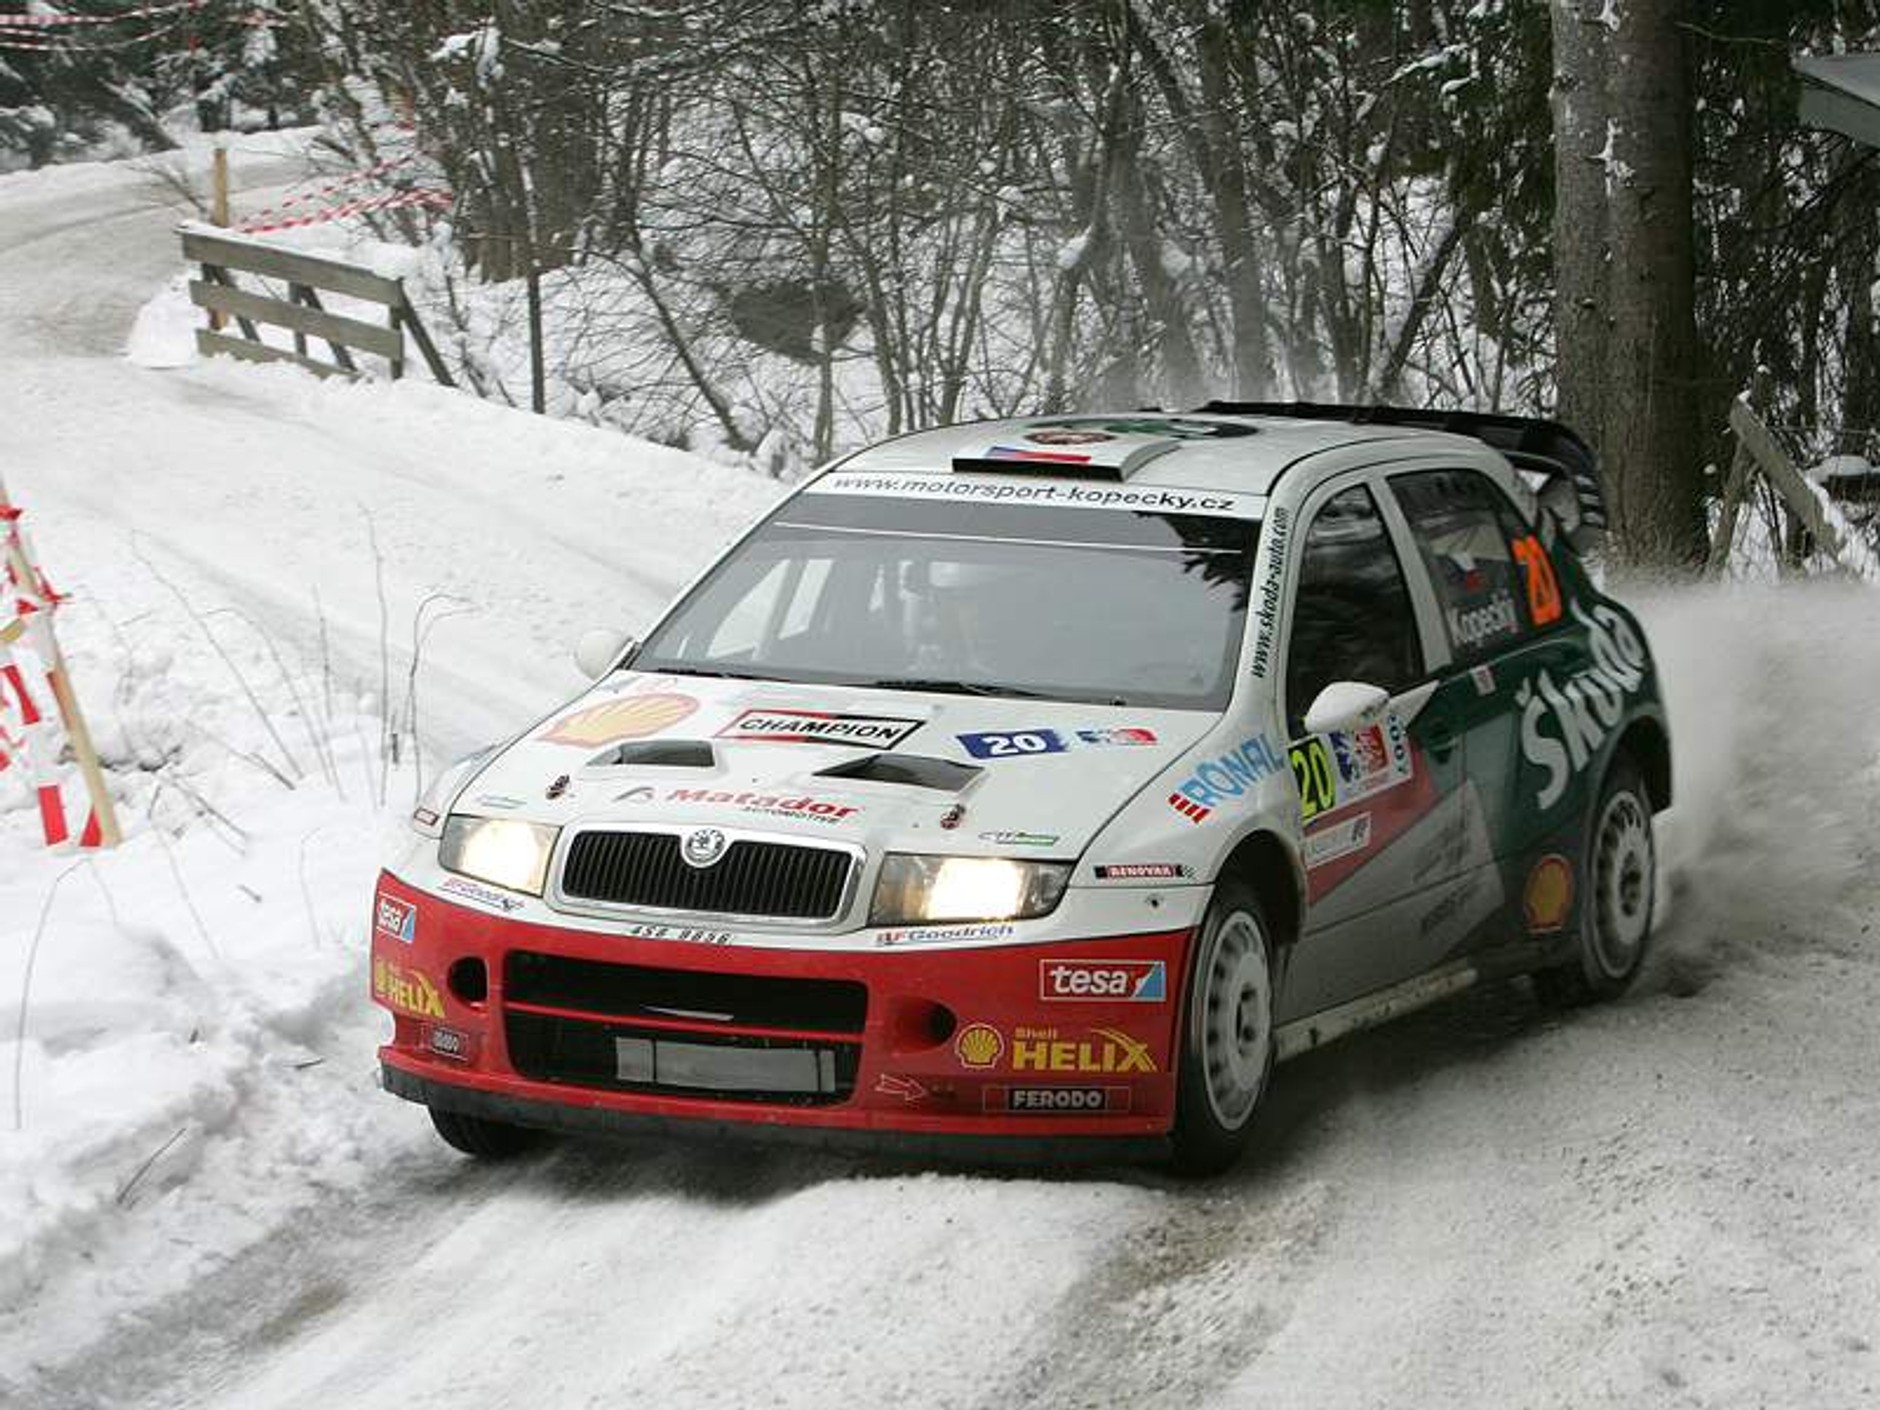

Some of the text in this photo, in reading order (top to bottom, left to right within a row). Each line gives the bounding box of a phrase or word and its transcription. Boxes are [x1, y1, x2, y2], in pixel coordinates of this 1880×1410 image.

[833, 475, 1237, 512] www.motorsport-kopecky.cz
[1251, 507, 1289, 678] www.skoda-auto.com
[740, 717, 904, 741] CHAMPION
[981, 734, 1047, 756] 20
[1180, 733, 1285, 807] RONAL
[1291, 742, 1335, 820] 20
[668, 788, 858, 817] Matador
[1050, 966, 1128, 994] tesa
[1012, 1031, 1158, 1072] HELIX
[1012, 1090, 1103, 1109] FERODO
